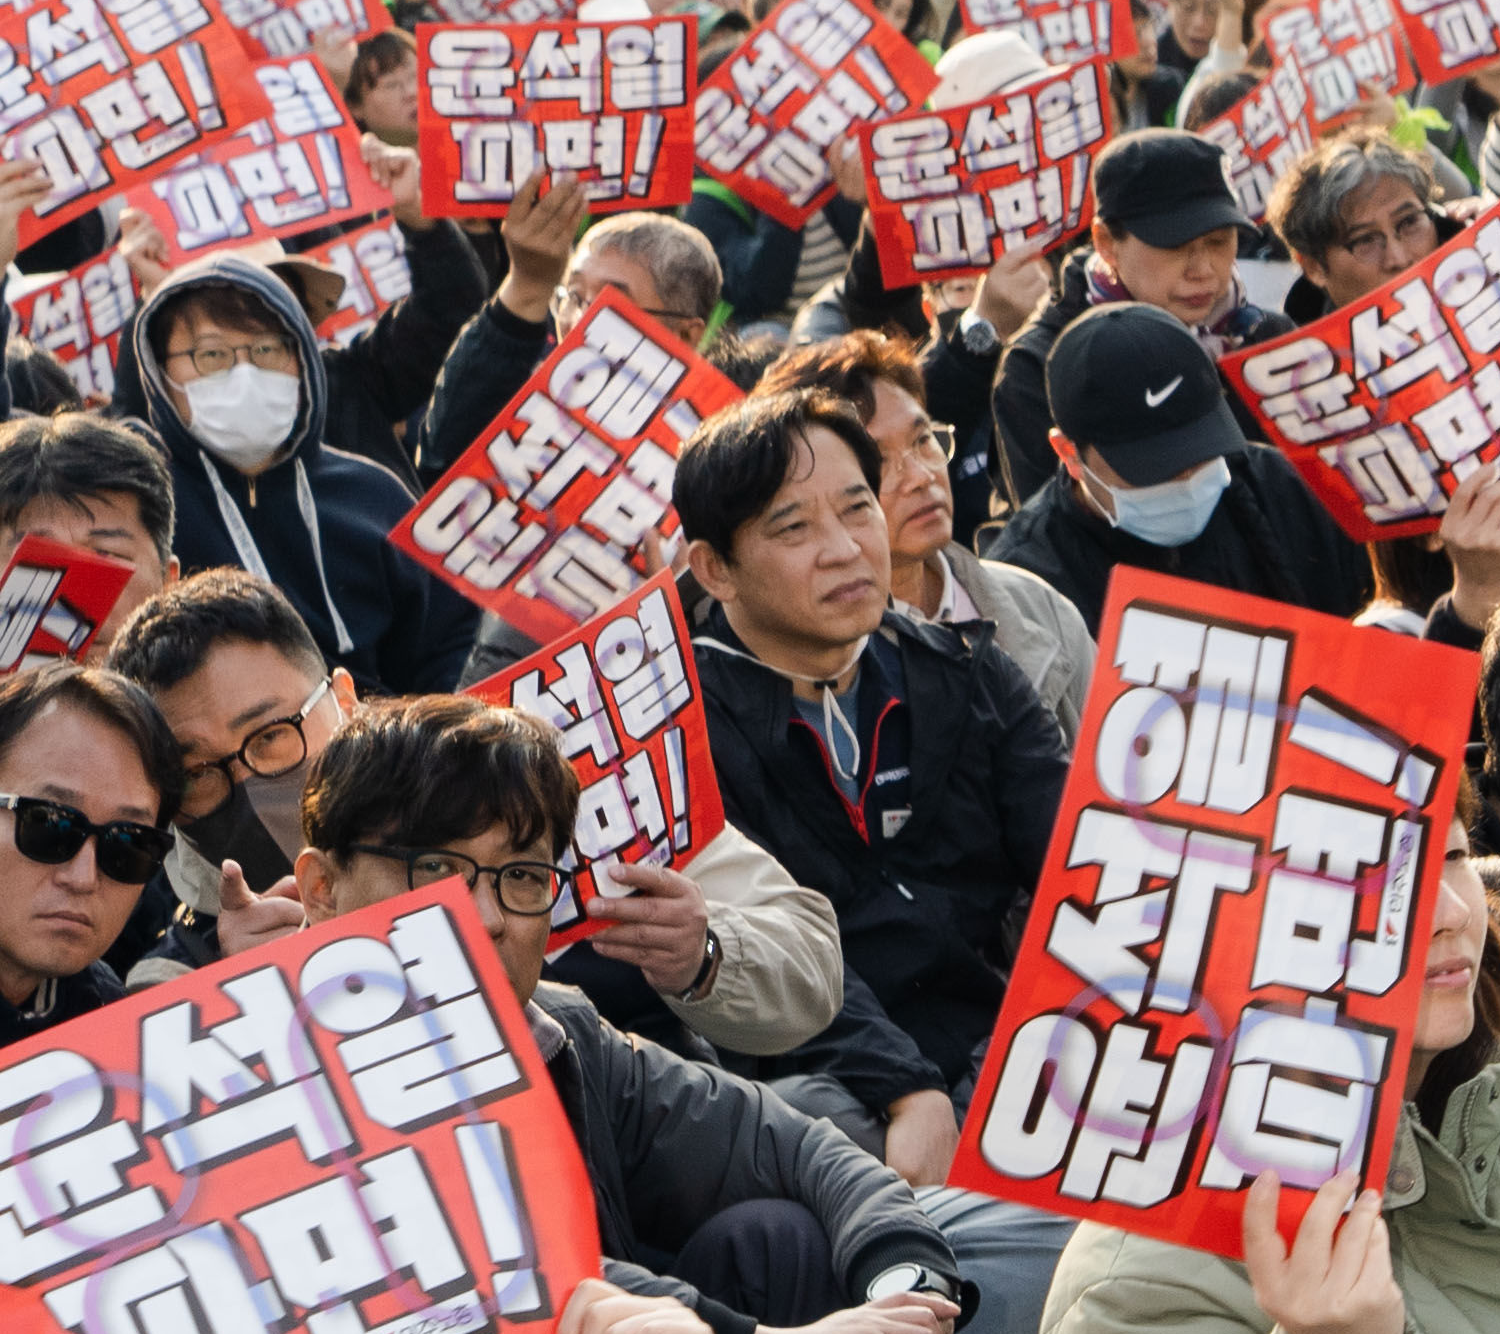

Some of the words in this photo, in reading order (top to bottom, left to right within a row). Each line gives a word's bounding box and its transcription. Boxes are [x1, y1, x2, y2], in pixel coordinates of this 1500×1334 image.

[427, 21, 689, 117] 윤석열
[1005, 2, 1115, 61] 면!
[2, 41, 226, 219] 파면!
[450, 113, 666, 204] 파면!
[871, 66, 1104, 200] 윤석열
[905, 153, 1092, 272] 파면!
[28, 264, 136, 357] 석열
[412, 304, 690, 591] 윤석열
[510, 587, 694, 767] 석열
[552, 725, 688, 929] 면!
[980, 603, 1294, 1209] 윤석열
[1198, 685, 1440, 1212] 파면!
